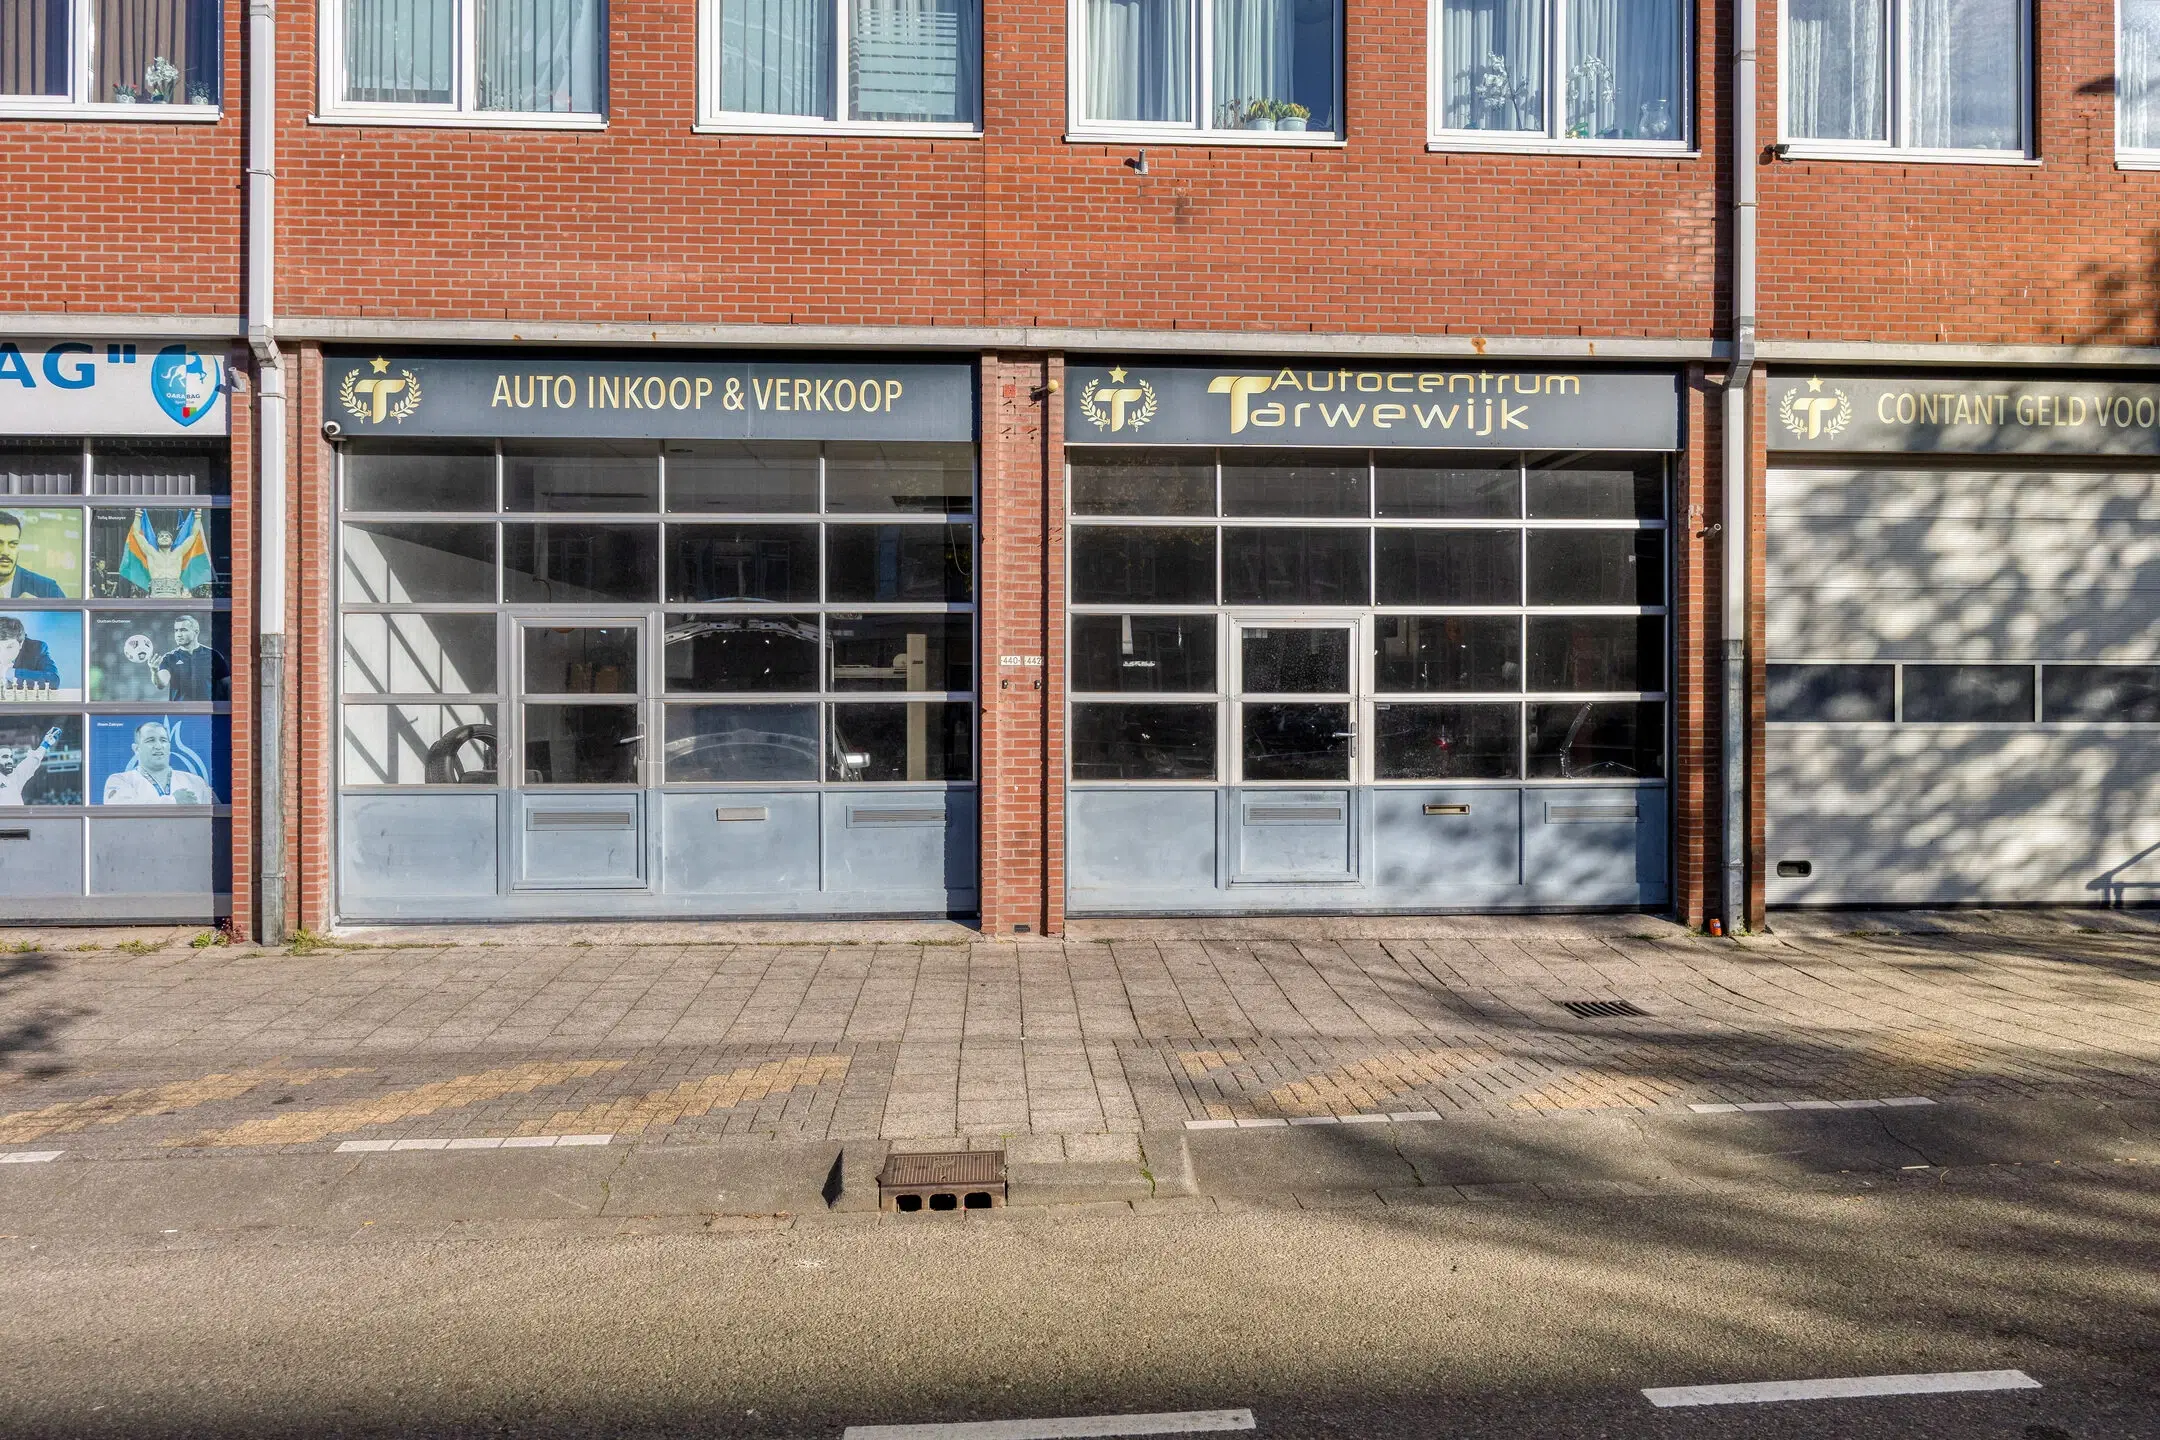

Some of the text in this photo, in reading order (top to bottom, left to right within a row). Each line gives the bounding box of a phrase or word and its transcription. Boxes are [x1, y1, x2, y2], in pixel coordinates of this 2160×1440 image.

[491, 375, 903, 413] AUTO INKOOP & VERKOOP
[1271, 367, 1580, 395] Autocentrum
[1877, 392, 2160, 428] CONTANT GELD VOO
